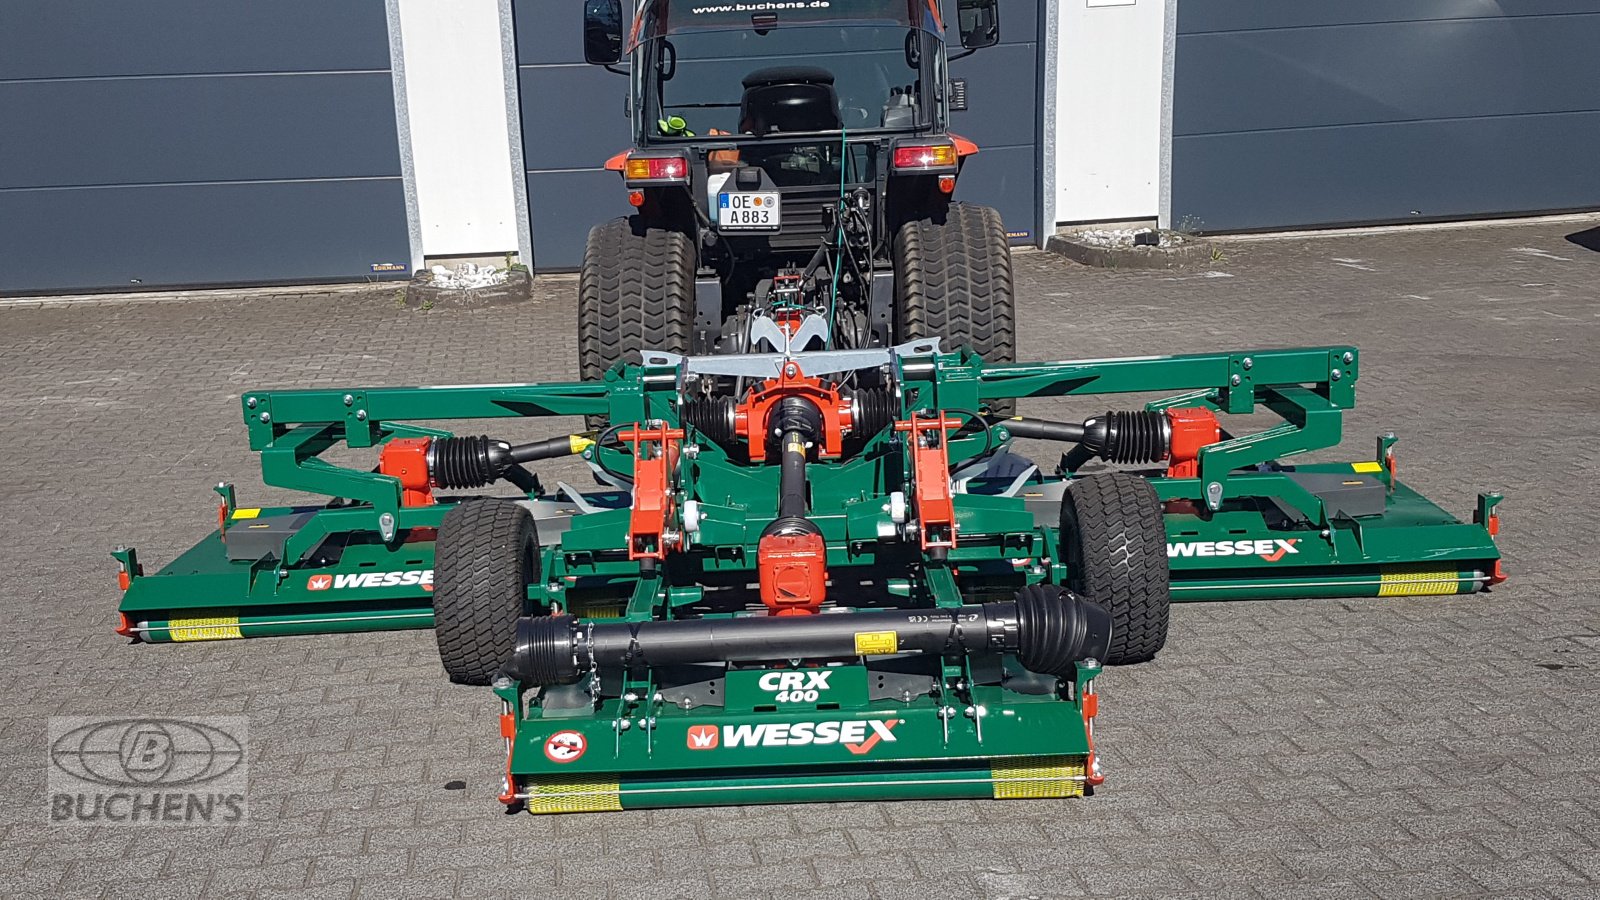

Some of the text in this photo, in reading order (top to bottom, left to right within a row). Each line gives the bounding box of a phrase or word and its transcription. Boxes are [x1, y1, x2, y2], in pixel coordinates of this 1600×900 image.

[692, 1, 830, 14] www.buchens.de
[732, 195, 751, 209] OE
[1166, 538, 1299, 562] WESSEX
[334, 569, 434, 592] WESSE
[758, 670, 833, 691] CRX
[775, 689, 819, 703] 400
[722, 719, 900, 755] WESSEX
